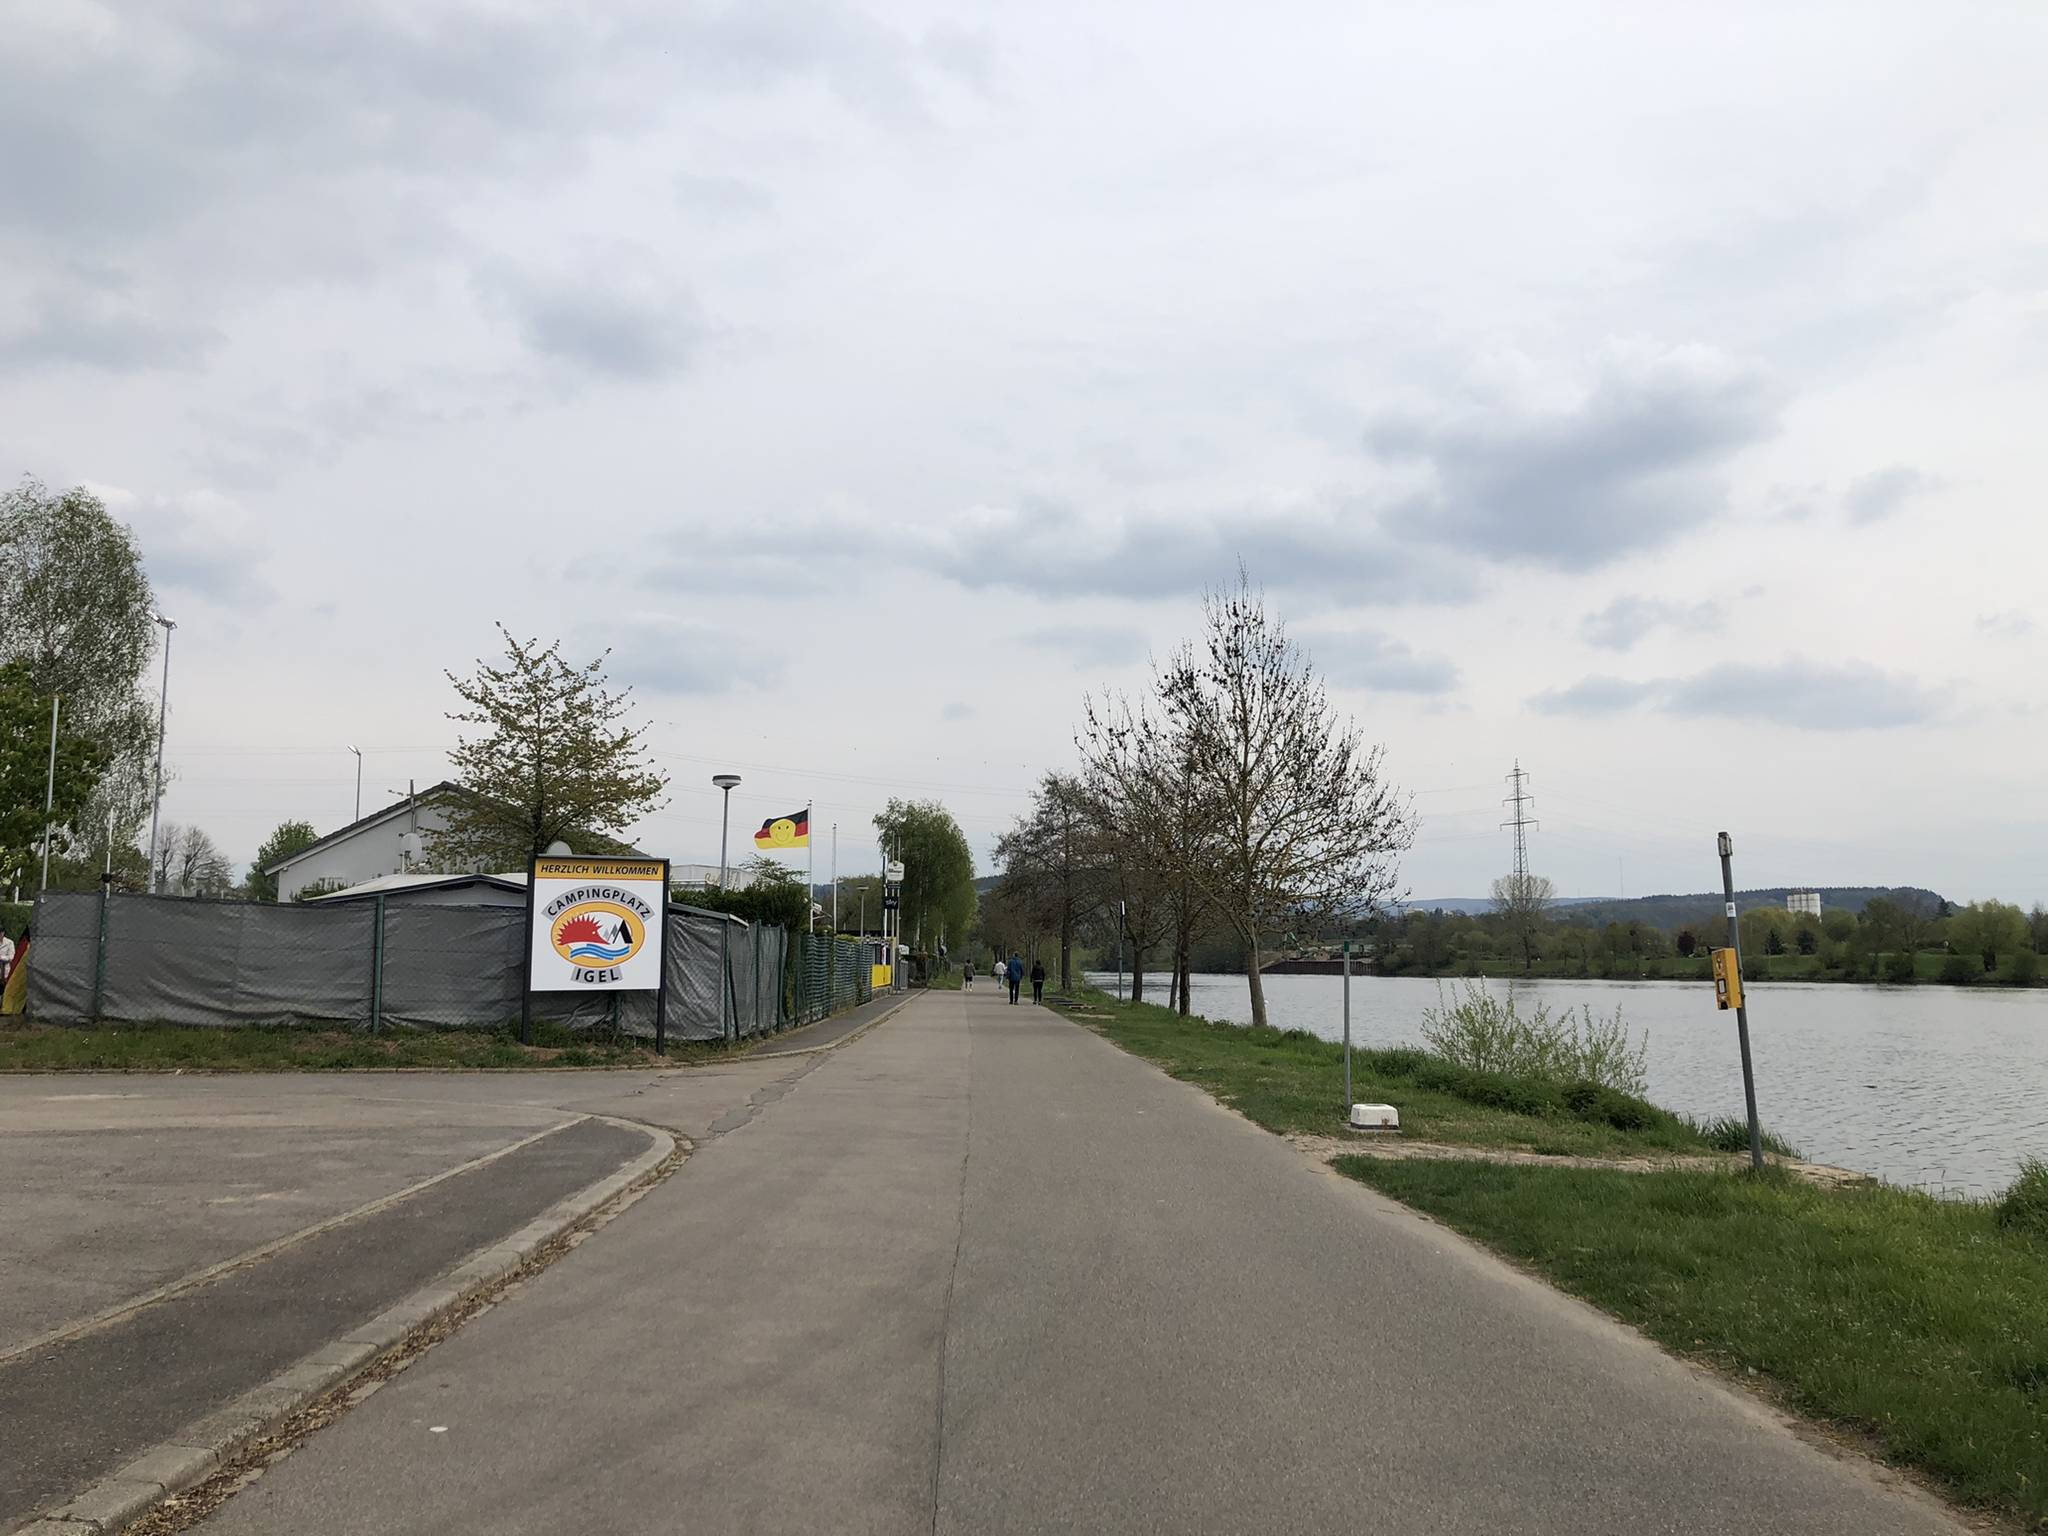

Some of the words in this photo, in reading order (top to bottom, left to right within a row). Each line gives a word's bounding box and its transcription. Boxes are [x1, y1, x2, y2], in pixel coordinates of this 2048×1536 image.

[541, 864, 590, 874] HERZLICH
[592, 865, 659, 876] WILLKOMMEN
[547, 888, 651, 919] CAMPINGPLATZ
[575, 968, 620, 983] IGEL
